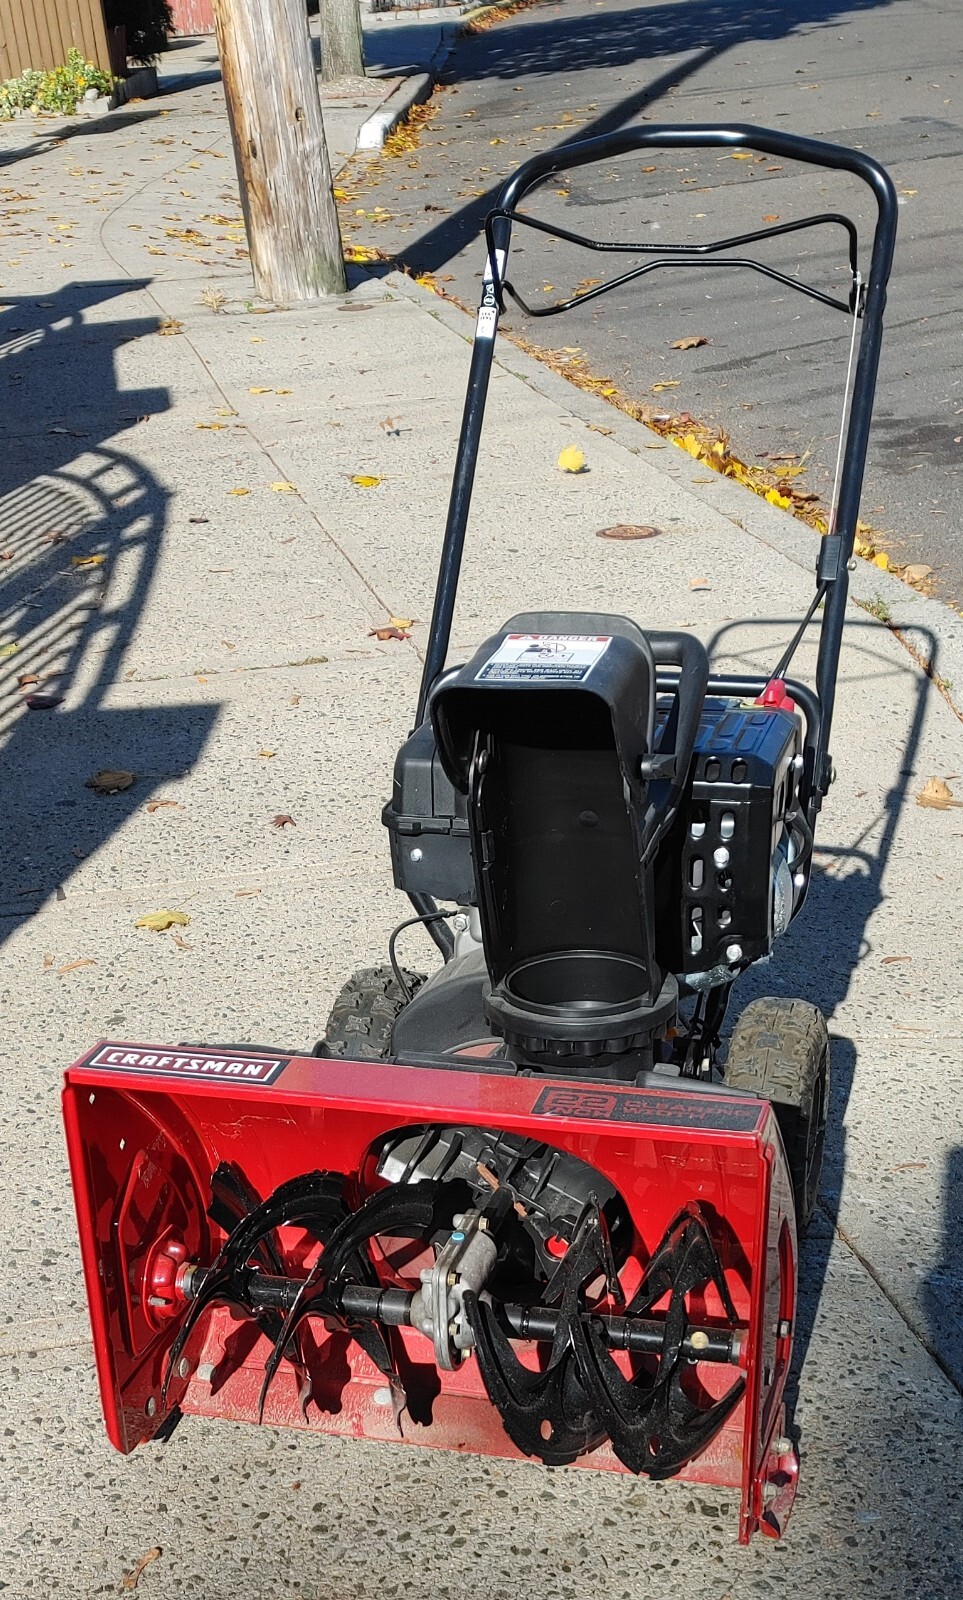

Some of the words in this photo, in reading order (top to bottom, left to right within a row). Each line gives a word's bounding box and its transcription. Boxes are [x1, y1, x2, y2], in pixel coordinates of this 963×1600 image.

[539, 634, 596, 642] DANGER
[106, 1052, 263, 1076] CRAFTSMAN
[551, 1093, 609, 1109] 22
